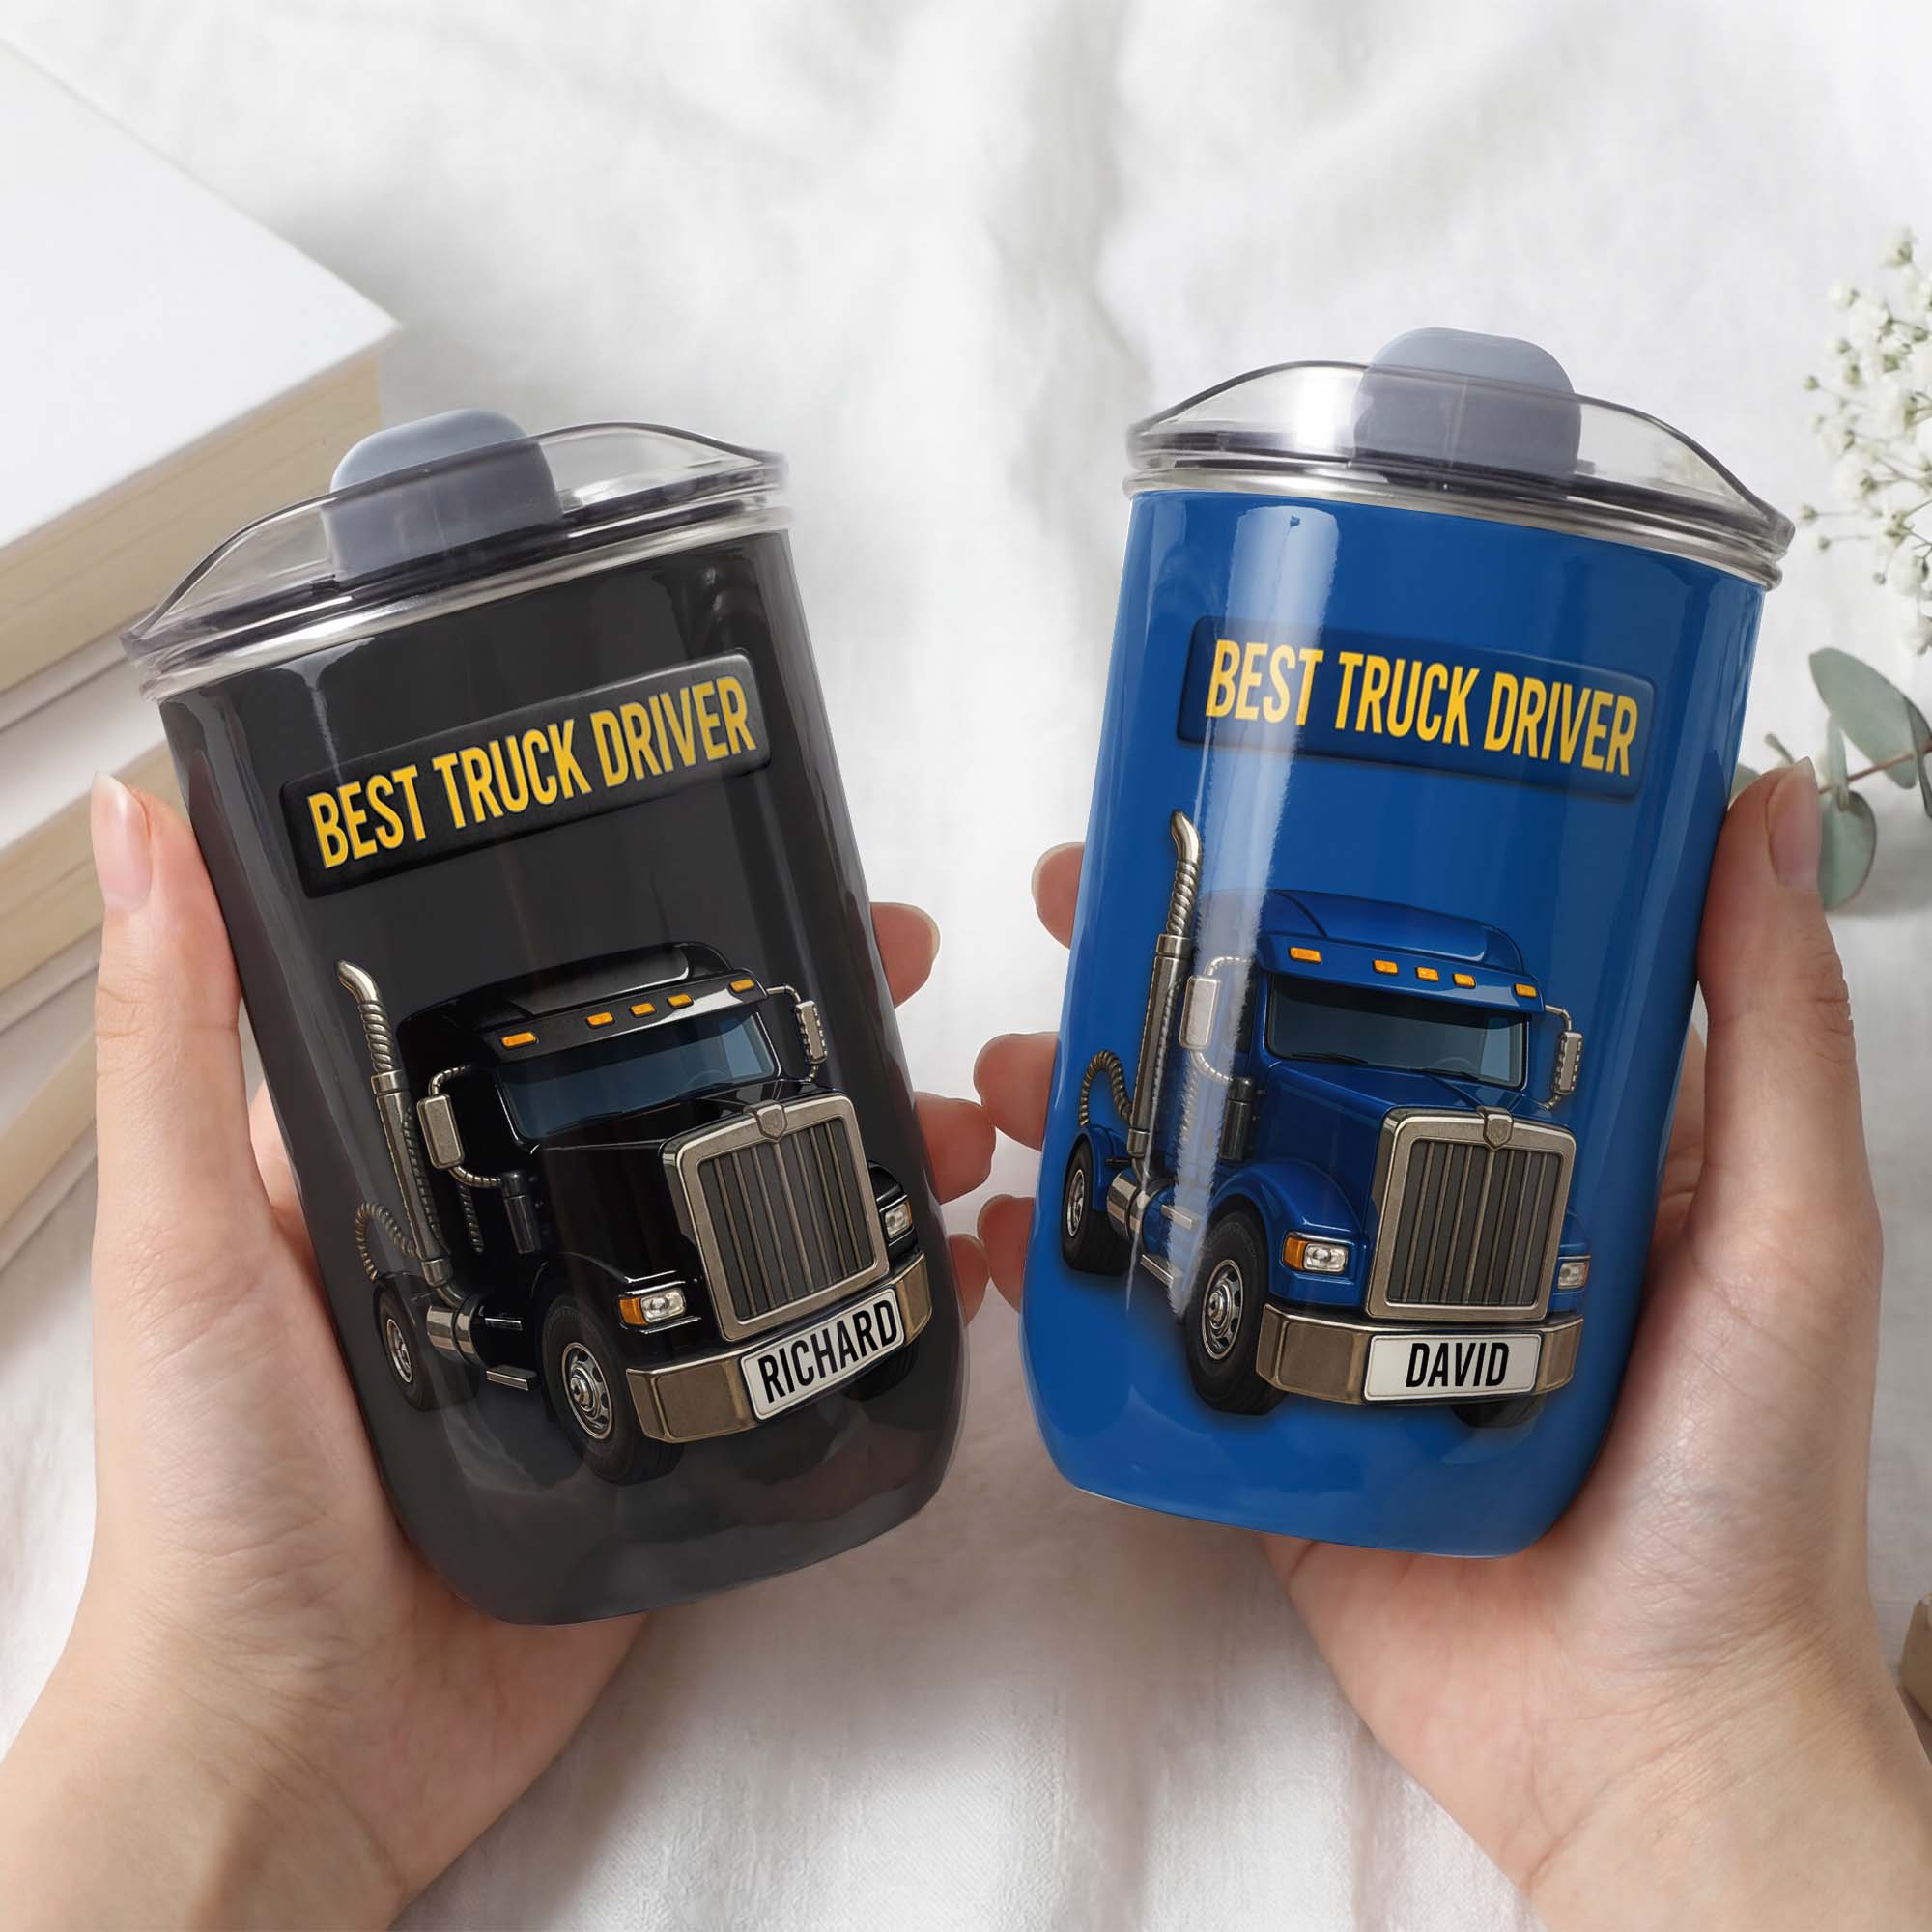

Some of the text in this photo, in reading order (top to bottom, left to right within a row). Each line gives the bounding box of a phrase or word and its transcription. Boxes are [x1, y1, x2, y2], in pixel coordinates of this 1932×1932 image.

[1206, 639, 1638, 776] BEST TRUCK DRIVER
[307, 675, 756, 868] BEST TRUCK DRIVER
[757, 1299, 897, 1404] RICHARD
[1406, 1342, 1510, 1388] DAVID
